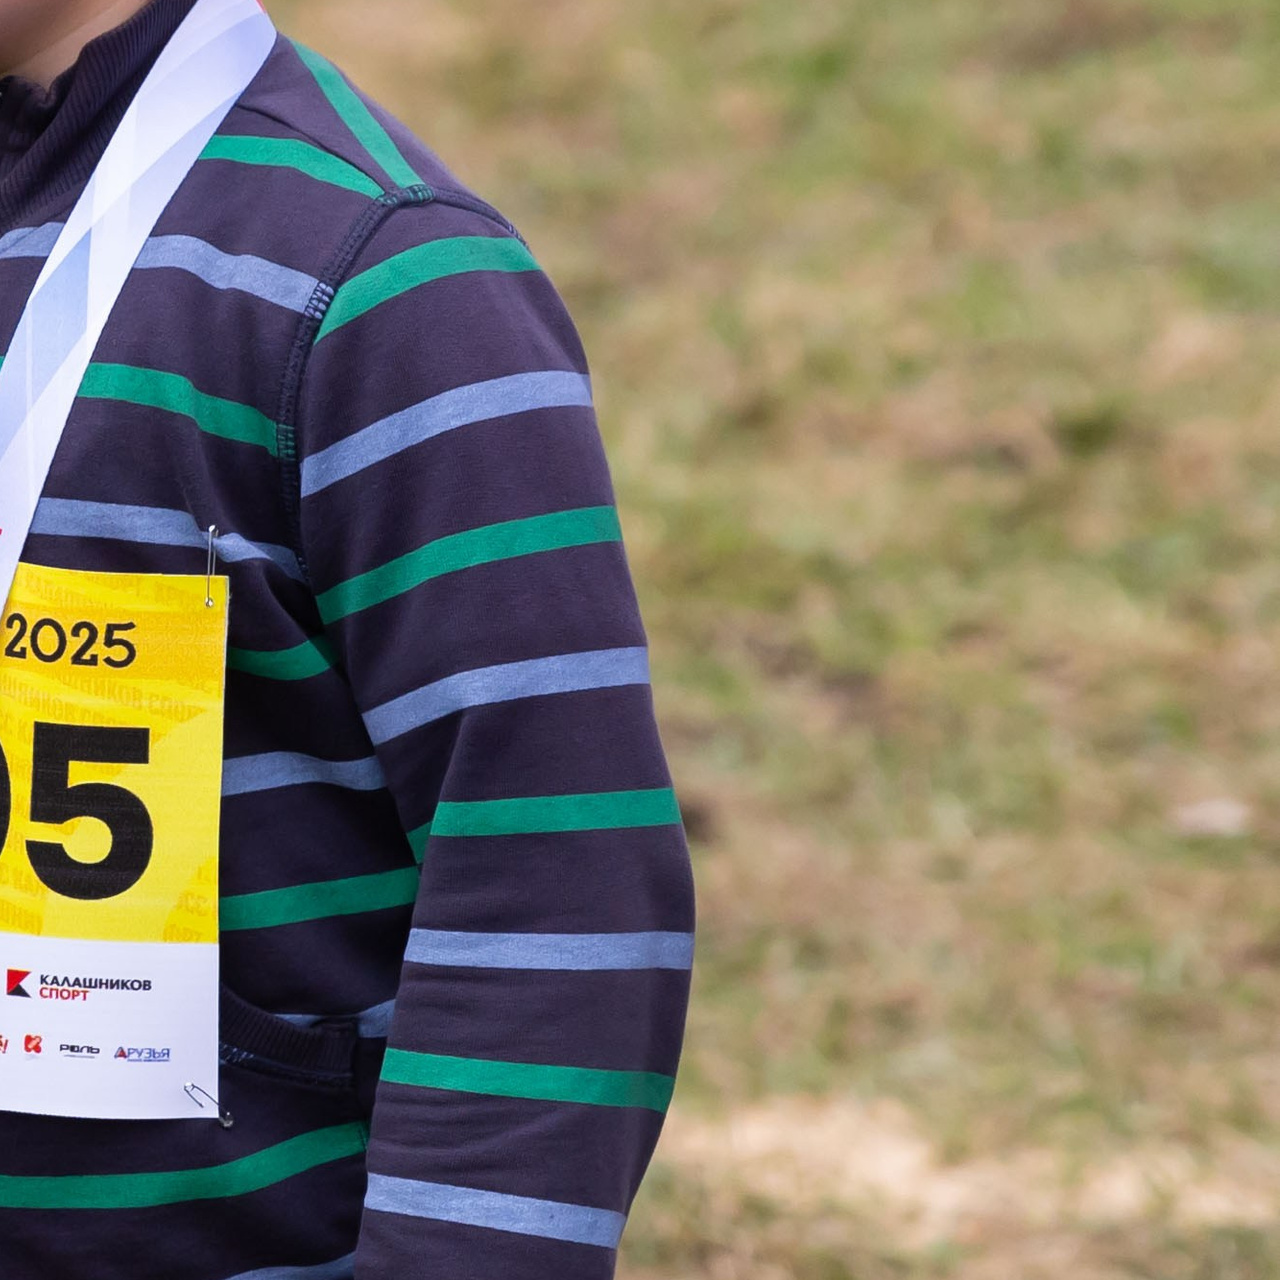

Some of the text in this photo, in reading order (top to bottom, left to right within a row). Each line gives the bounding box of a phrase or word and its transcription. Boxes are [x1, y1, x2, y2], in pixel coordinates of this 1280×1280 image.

[4, 612, 137, 668] 2025
[39, 974, 153, 992] КАЛАШНИКОВ
[39, 987, 90, 1001] СПОРТ
[113, 1045, 171, 1060] ДРУЗЬЯ
